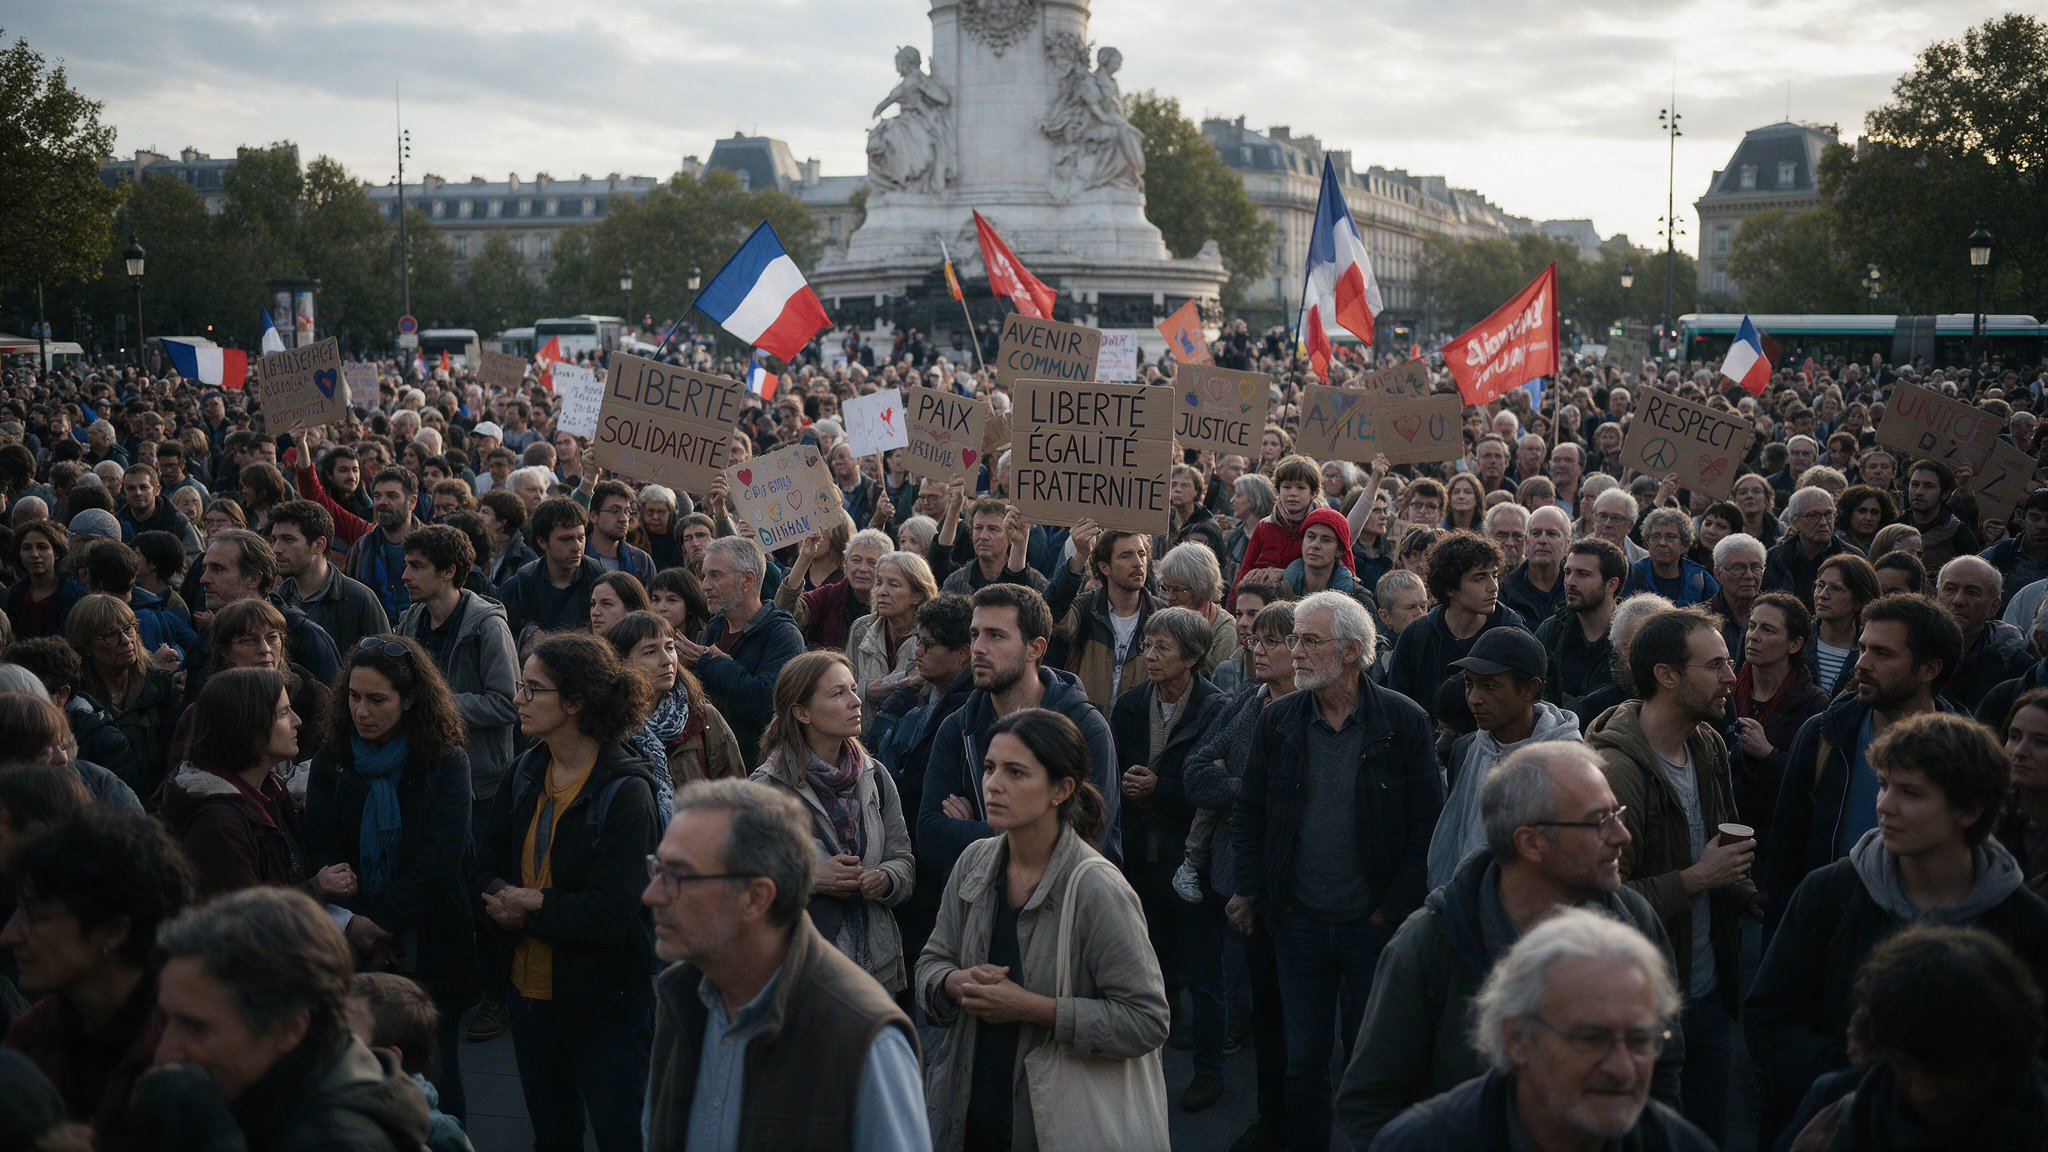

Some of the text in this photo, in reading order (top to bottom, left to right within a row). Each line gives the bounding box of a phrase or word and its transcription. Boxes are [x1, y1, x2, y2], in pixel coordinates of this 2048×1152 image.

[1003, 321, 1082, 357] AVENIR
[1008, 350, 1090, 381] COMMUN
[613, 362, 739, 424] LIBERTÉ
[1031, 387, 1147, 428] LIBERTÉ
[918, 394, 973, 435] PAIX
[1175, 412, 1251, 447] JUSTICE
[1642, 395, 1743, 451] RESPECT
[600, 415, 727, 470] SOLIDARITÉ
[1028, 425, 1139, 468] ÉGALITÉ
[1017, 469, 1166, 511] FRATERNITÉ
